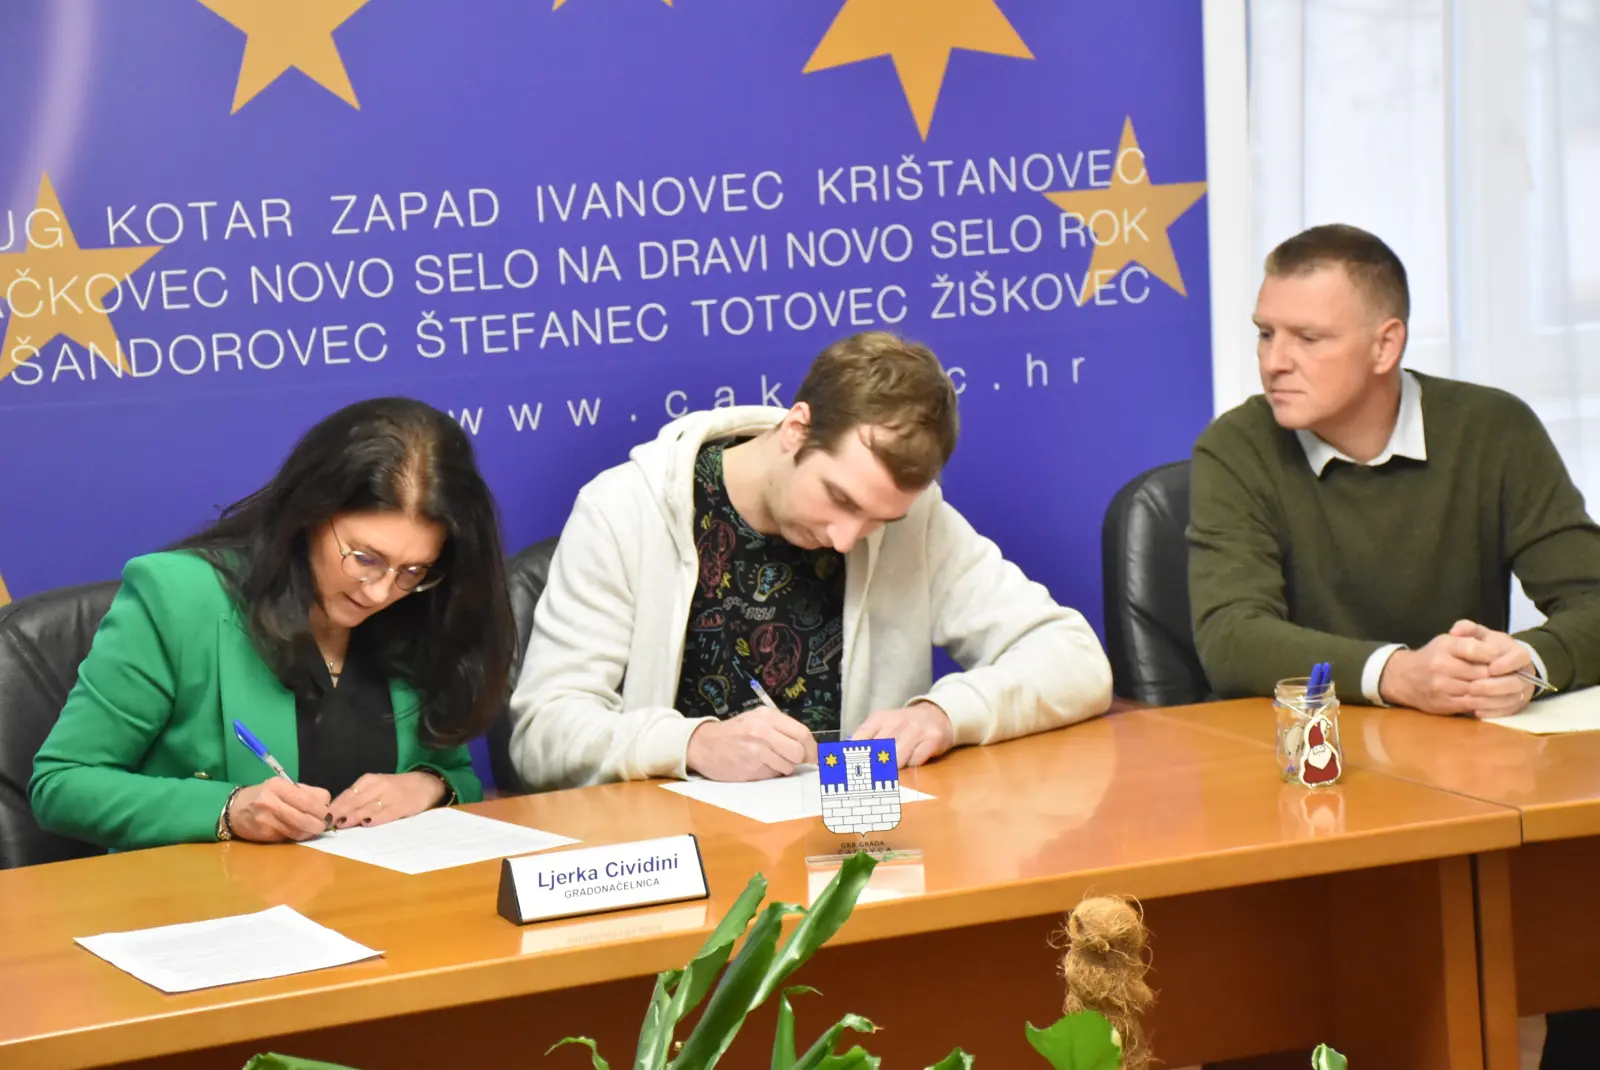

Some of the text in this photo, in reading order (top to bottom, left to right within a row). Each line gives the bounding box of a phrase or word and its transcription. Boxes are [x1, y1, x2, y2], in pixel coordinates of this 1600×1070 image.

[107, 198, 293, 245] KOTAR
[330, 188, 500, 235] ZAPAD
[536, 171, 784, 223] IVANOVEC
[817, 147, 1146, 206] KRIŠTANOVEC
[0, 207, 1149, 318] ČKOVEC NOVO SELO NA DRAVI NOVO SELO ROK
[11, 266, 1150, 386] ŠANDOROVEC ŠTEFANEC TOTOVEC ŽIŠKOVEC
[538, 853, 679, 890] Ljerka Cividini
[858, 840, 885, 848] GRADA
[564, 877, 660, 899] GRADONAČELNICA
